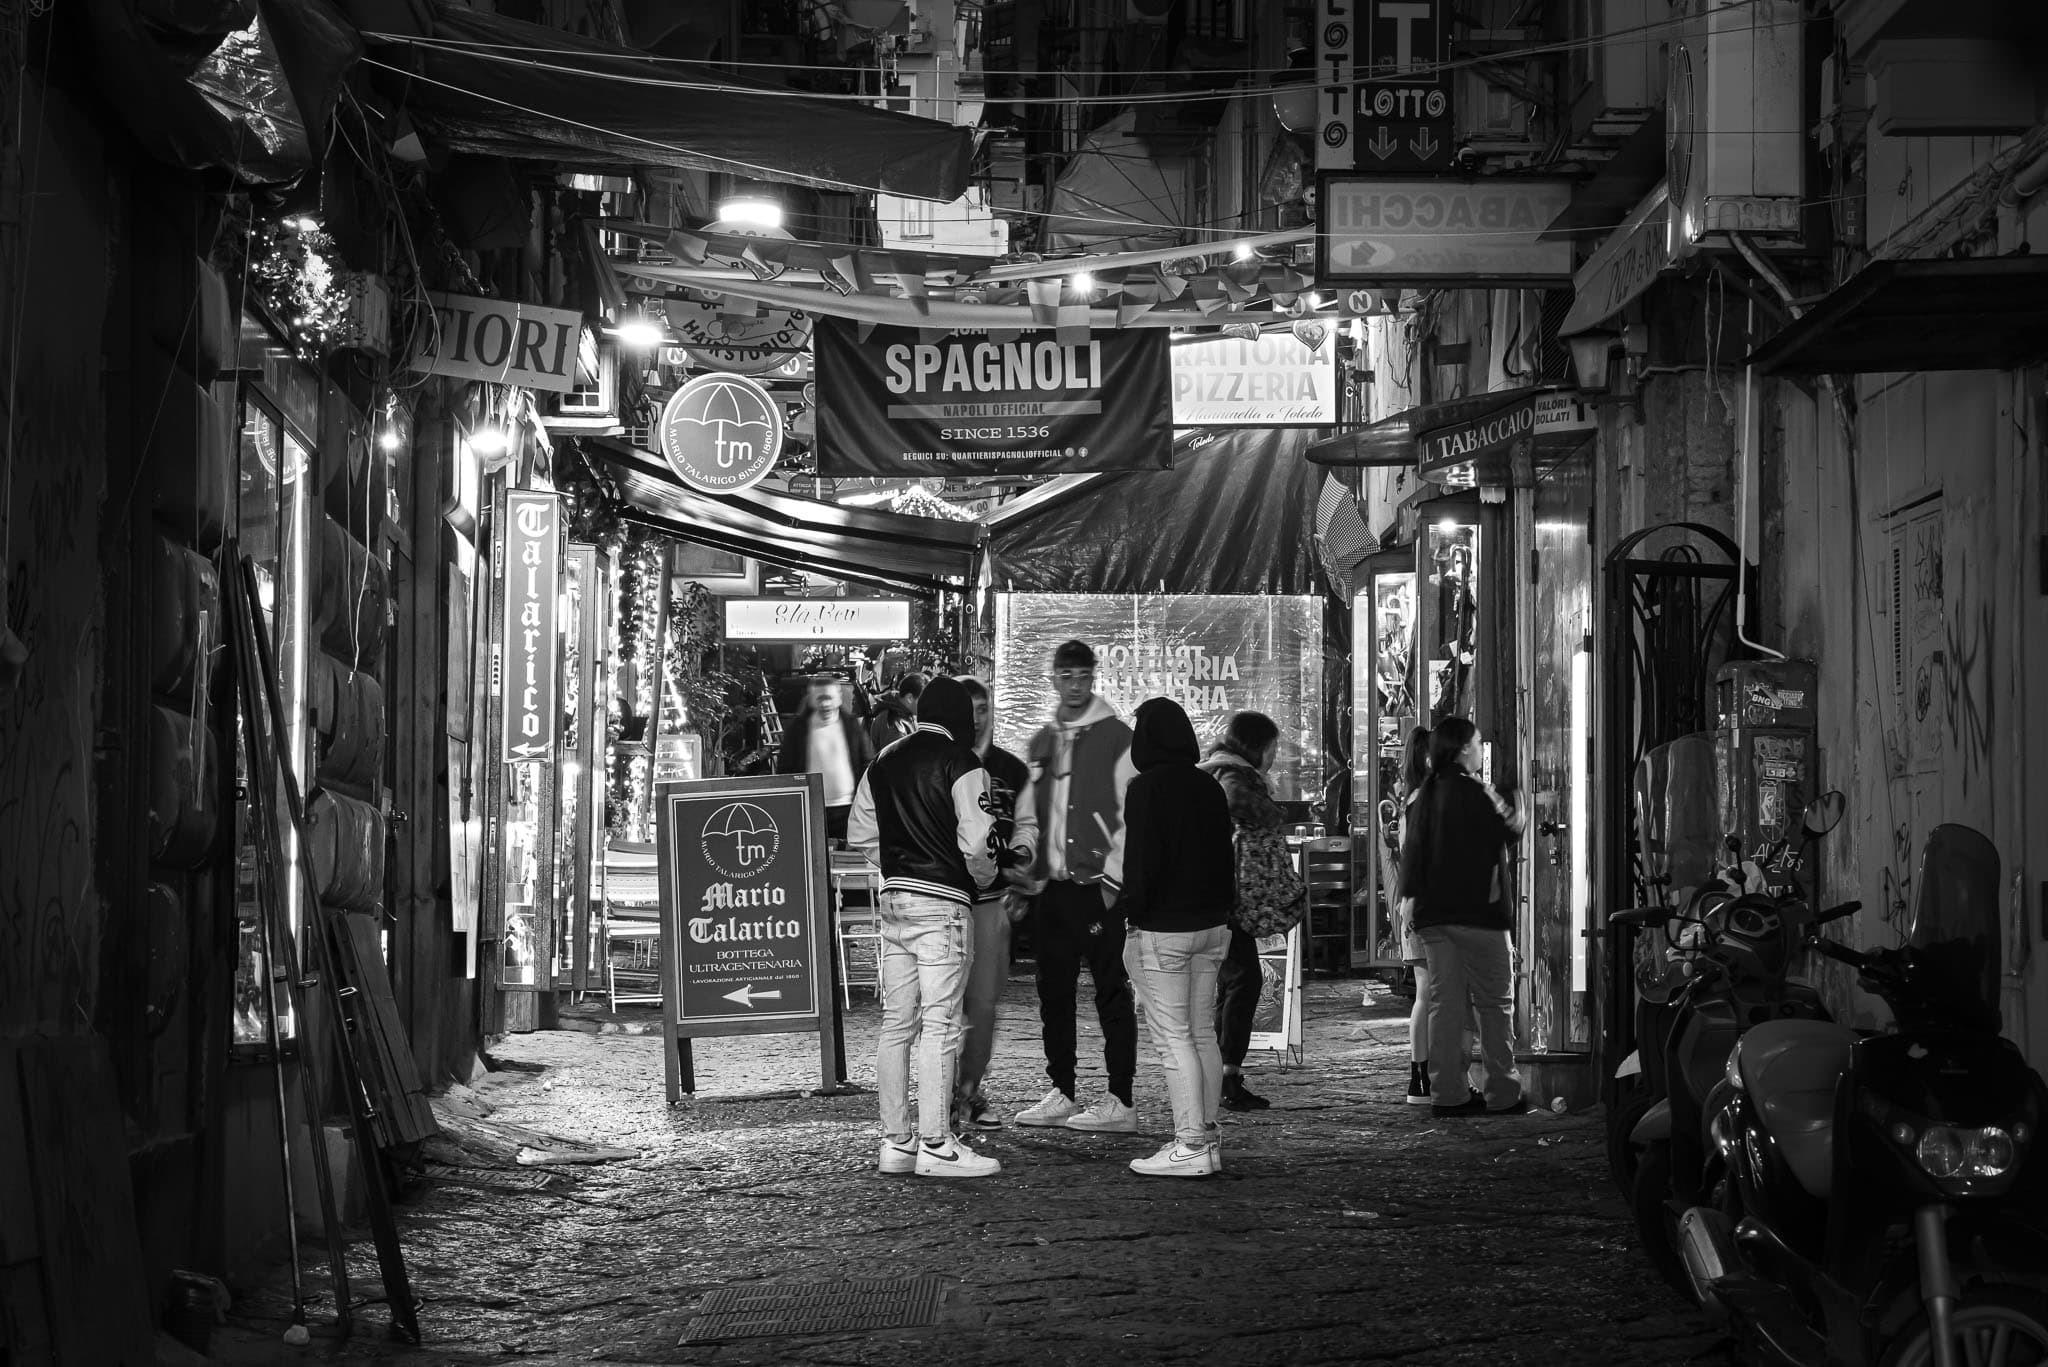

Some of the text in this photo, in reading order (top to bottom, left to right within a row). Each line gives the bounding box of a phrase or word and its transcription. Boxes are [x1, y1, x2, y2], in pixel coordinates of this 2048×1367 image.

[1360, 87, 1447, 119] LOTTO
[423, 306, 574, 377] FIORI
[885, 339, 1102, 394] SPAGNOLI
[1174, 372, 1318, 402] PIZZERIA
[943, 402, 1046, 417] NAPOLI OFFICIAL
[1279, 405, 1323, 421] Toledo
[1535, 411, 1570, 425] BOLLATI
[1537, 398, 1567, 412] VALORI
[668, 427, 686, 464] MARIO
[940, 425, 1050, 440] SINCE 1536
[1188, 432, 1216, 451] Toledo
[1421, 406, 1534, 464] IL TABACCAIO
[903, 452, 933, 461] SEGUICI
[516, 502, 551, 738] Talarico
[701, 840, 716, 866] MARIO
[700, 881, 786, 912] Mario
[688, 915, 801, 944] Talarico
[716, 948, 775, 960] BOTTEGA
